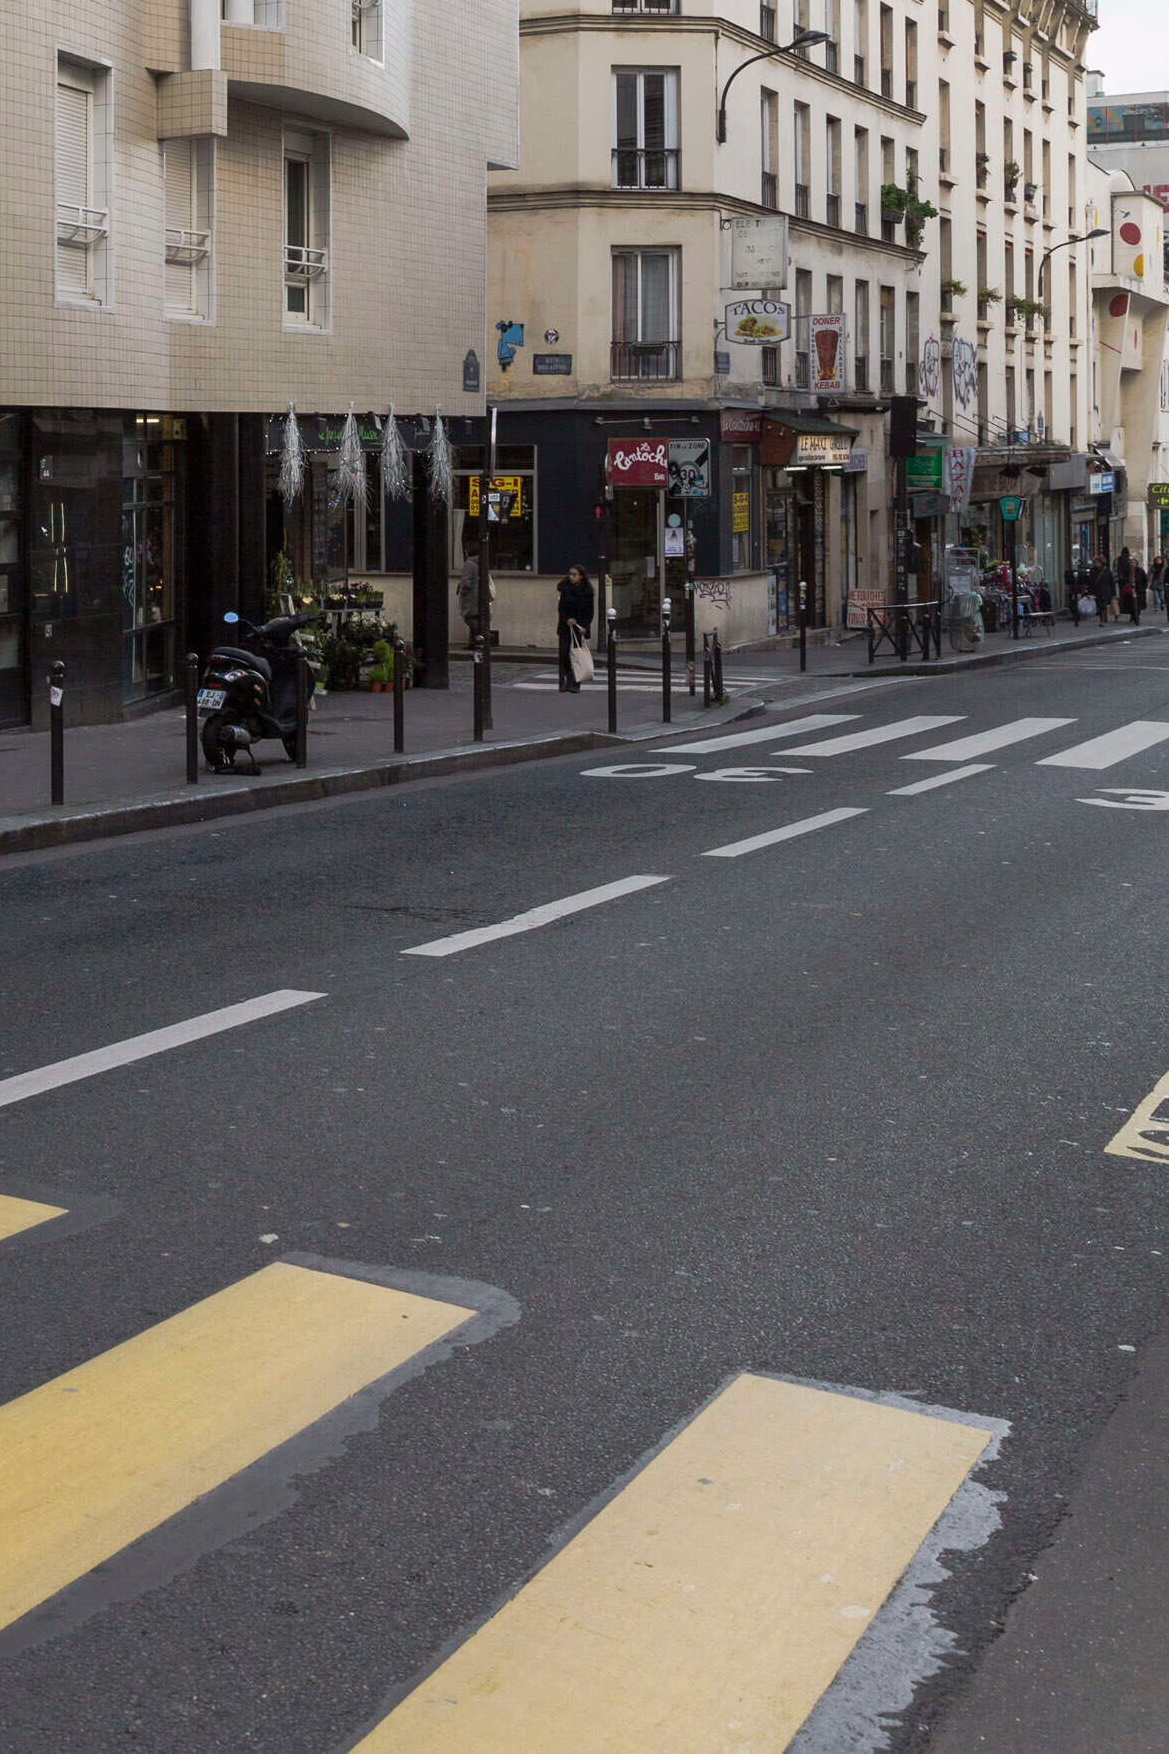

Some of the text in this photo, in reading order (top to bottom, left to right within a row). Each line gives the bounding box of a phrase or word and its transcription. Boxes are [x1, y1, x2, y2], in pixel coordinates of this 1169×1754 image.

[813, 317, 840, 325] DONER
[814, 382, 840, 390] KEBAB
[681, 469, 694, 482] 30
[950, 449, 966, 504] BAZAR
